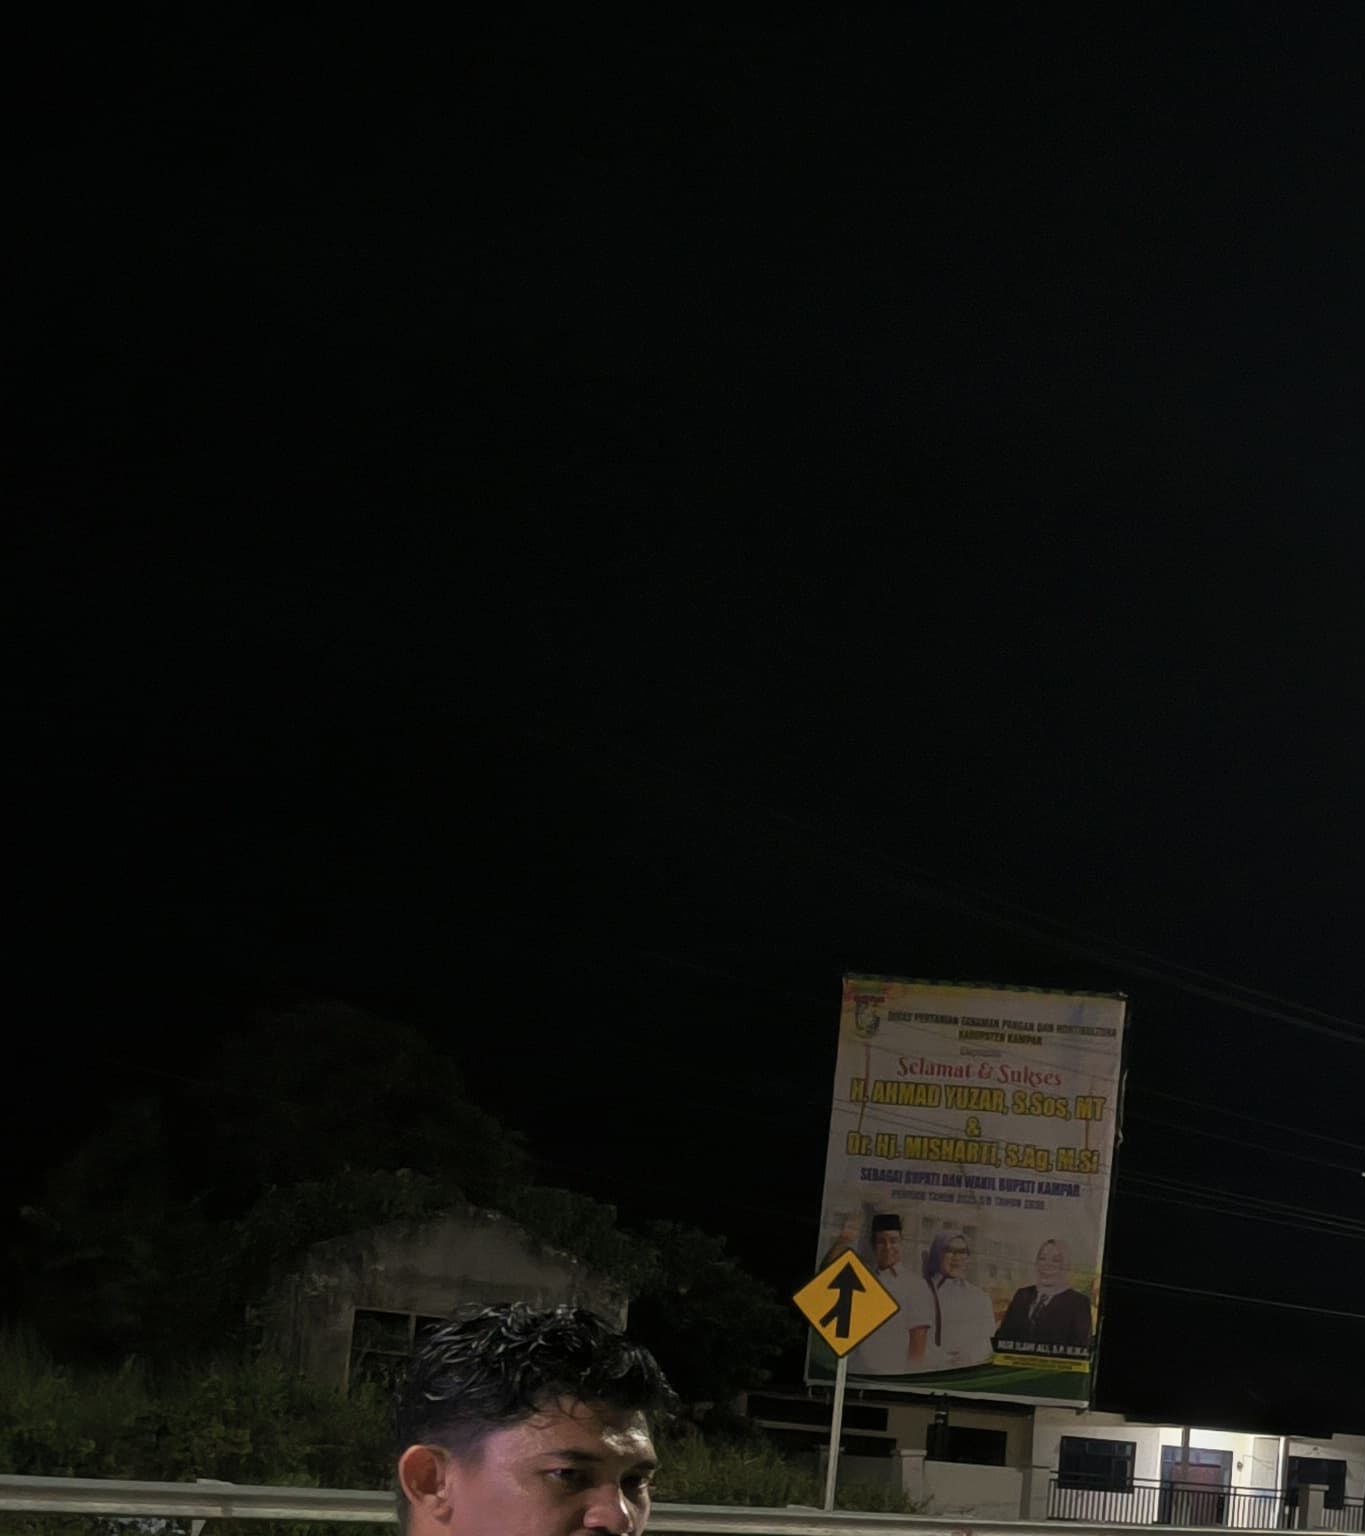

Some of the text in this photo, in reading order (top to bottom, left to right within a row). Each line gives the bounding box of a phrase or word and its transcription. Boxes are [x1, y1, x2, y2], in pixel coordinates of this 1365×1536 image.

[897, 1056, 1062, 1088] Selamat & Sukses
[851, 1078, 1106, 1121] H. AHMAD YUZAR, S.Sos, MT
[965, 1116, 981, 1137] &
[847, 1129, 872, 1157] Dr.
[875, 1132, 898, 1161] Hj.
[904, 1135, 1000, 1169] MISHARTI,
[1056, 1146, 1099, 1174] M.Si
[860, 1167, 1080, 1197] SEBAGAI BUPATI DAN WAKIL BUPATI KAMPAR
